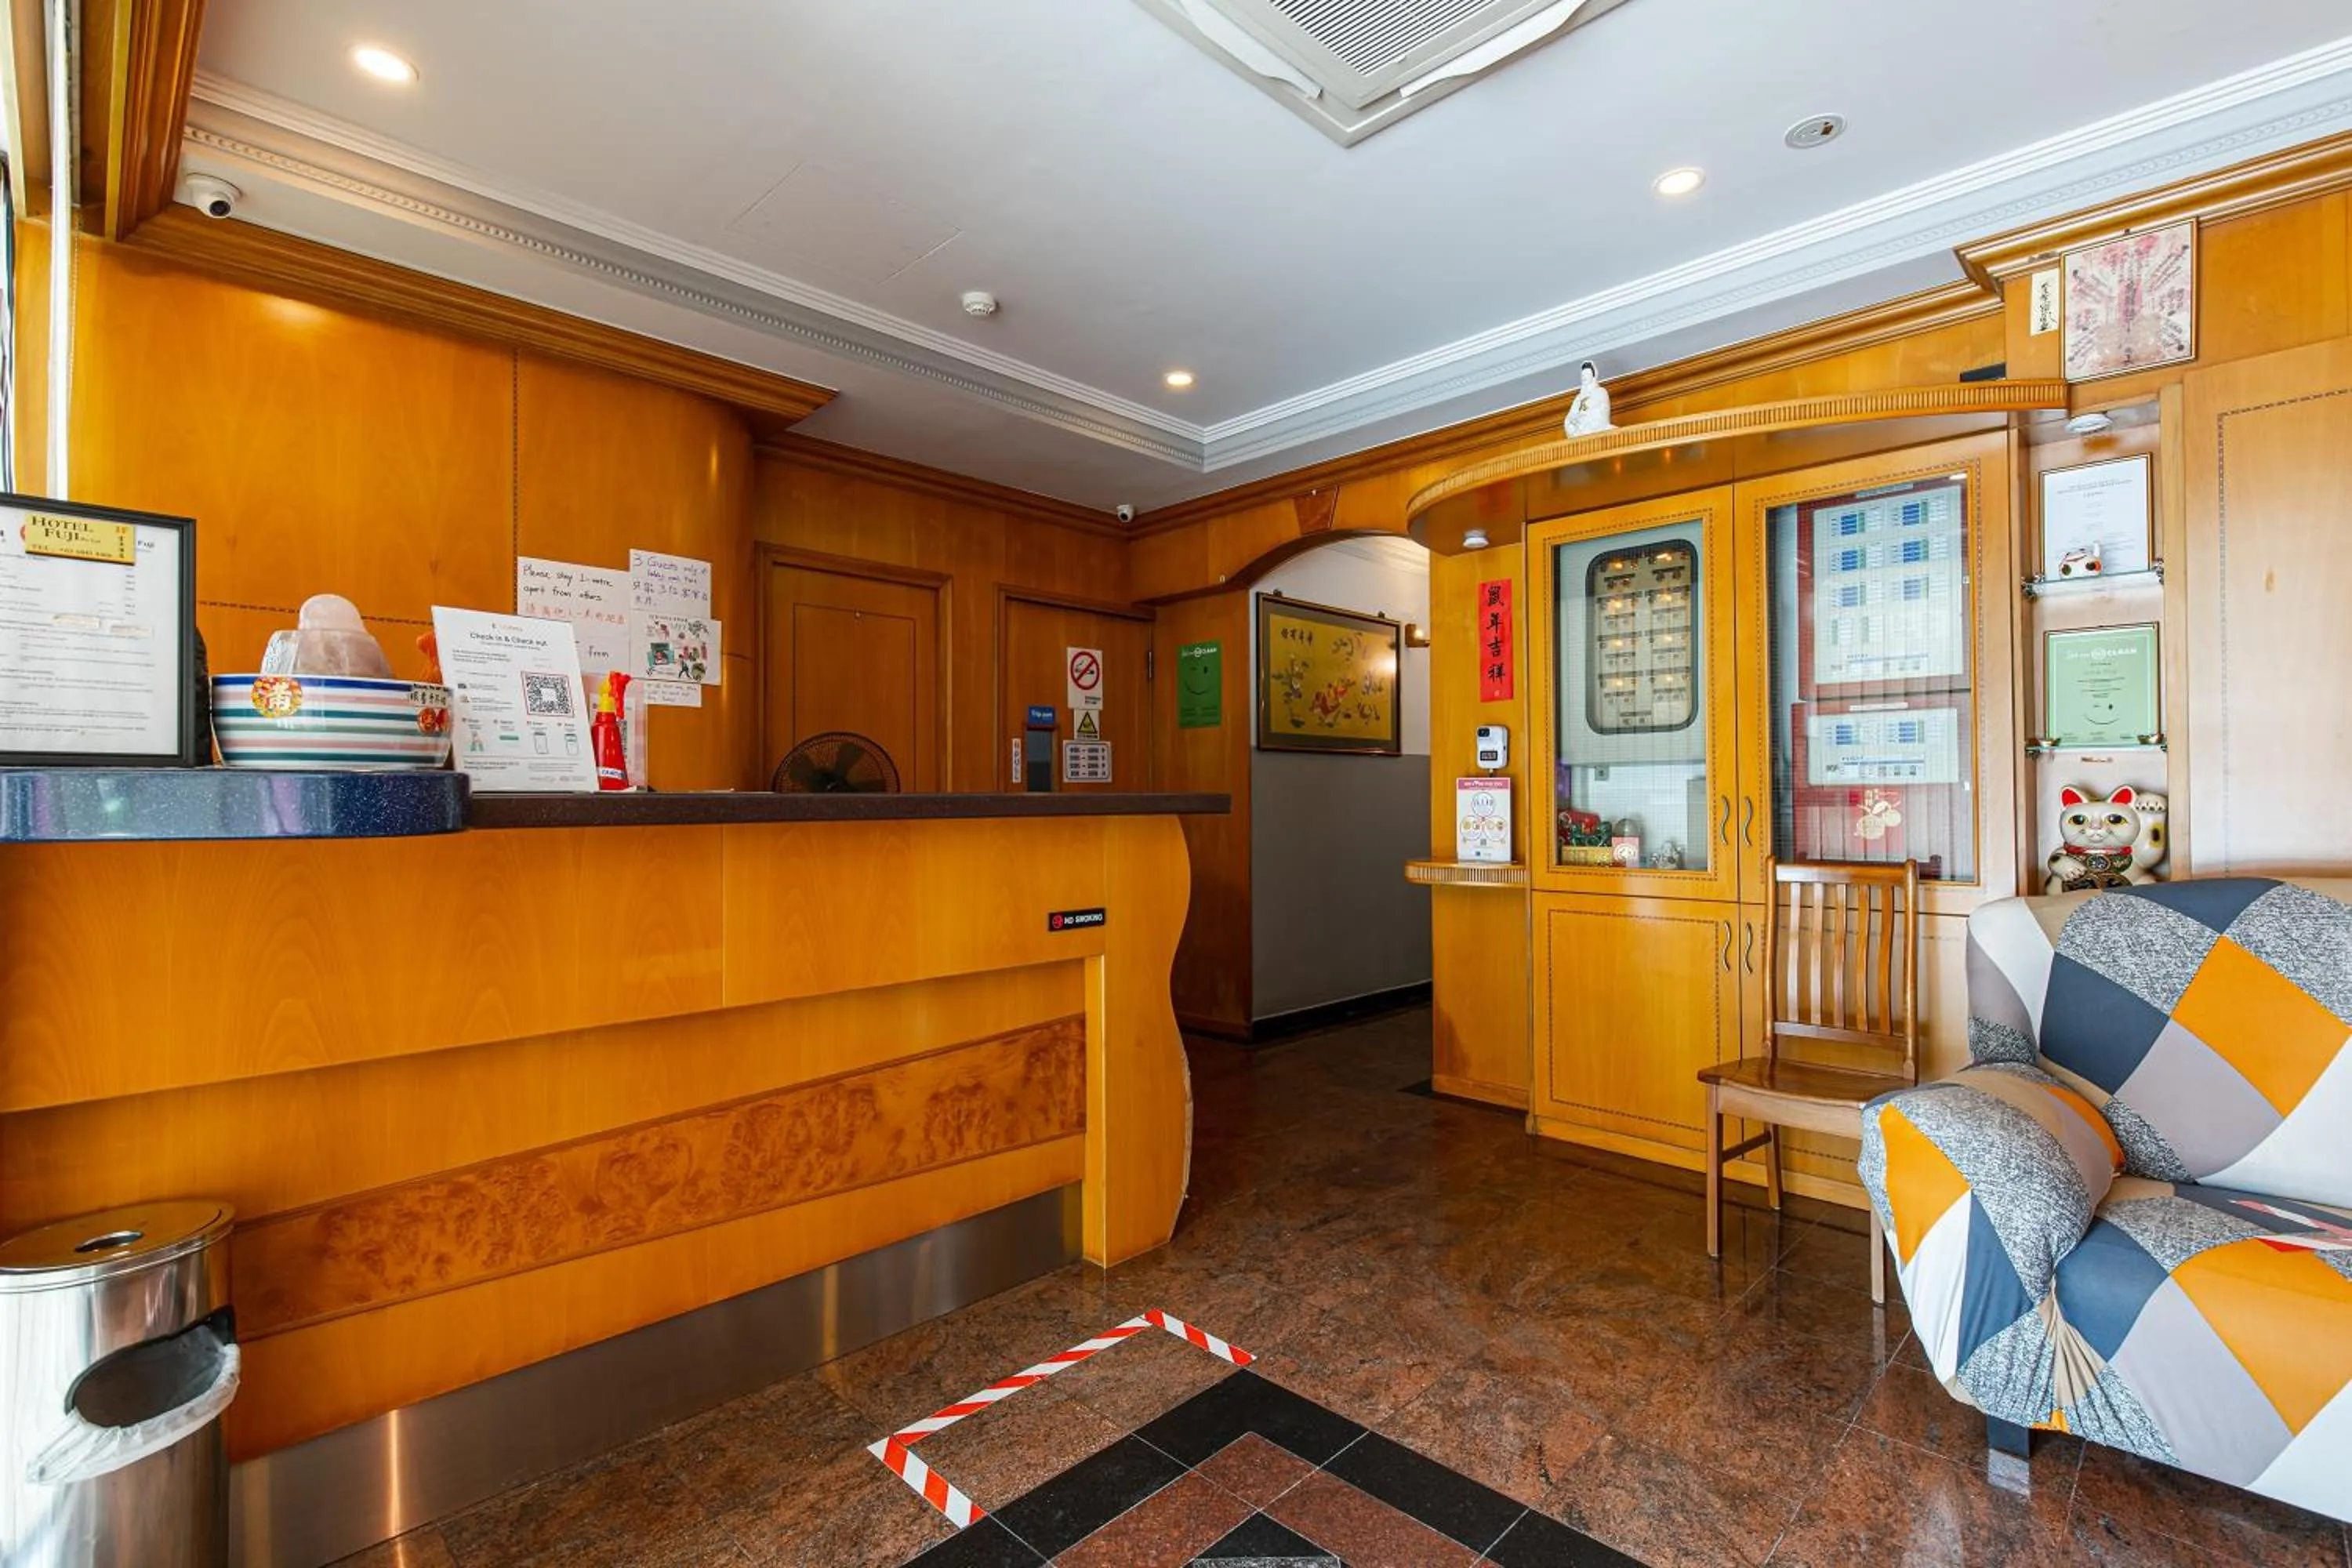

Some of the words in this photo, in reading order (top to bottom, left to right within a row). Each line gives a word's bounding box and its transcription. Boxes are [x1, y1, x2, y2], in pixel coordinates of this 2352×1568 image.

[32, 516, 93, 533] HOTEL
[45, 528, 80, 542] FUJI
[523, 564, 550, 579] Please
[557, 572, 573, 587] stay
[523, 586, 546, 596] apart
[553, 586, 572, 597] from
[470, 632, 494, 641] Check
[1075, 913, 1103, 924] SMOKING
